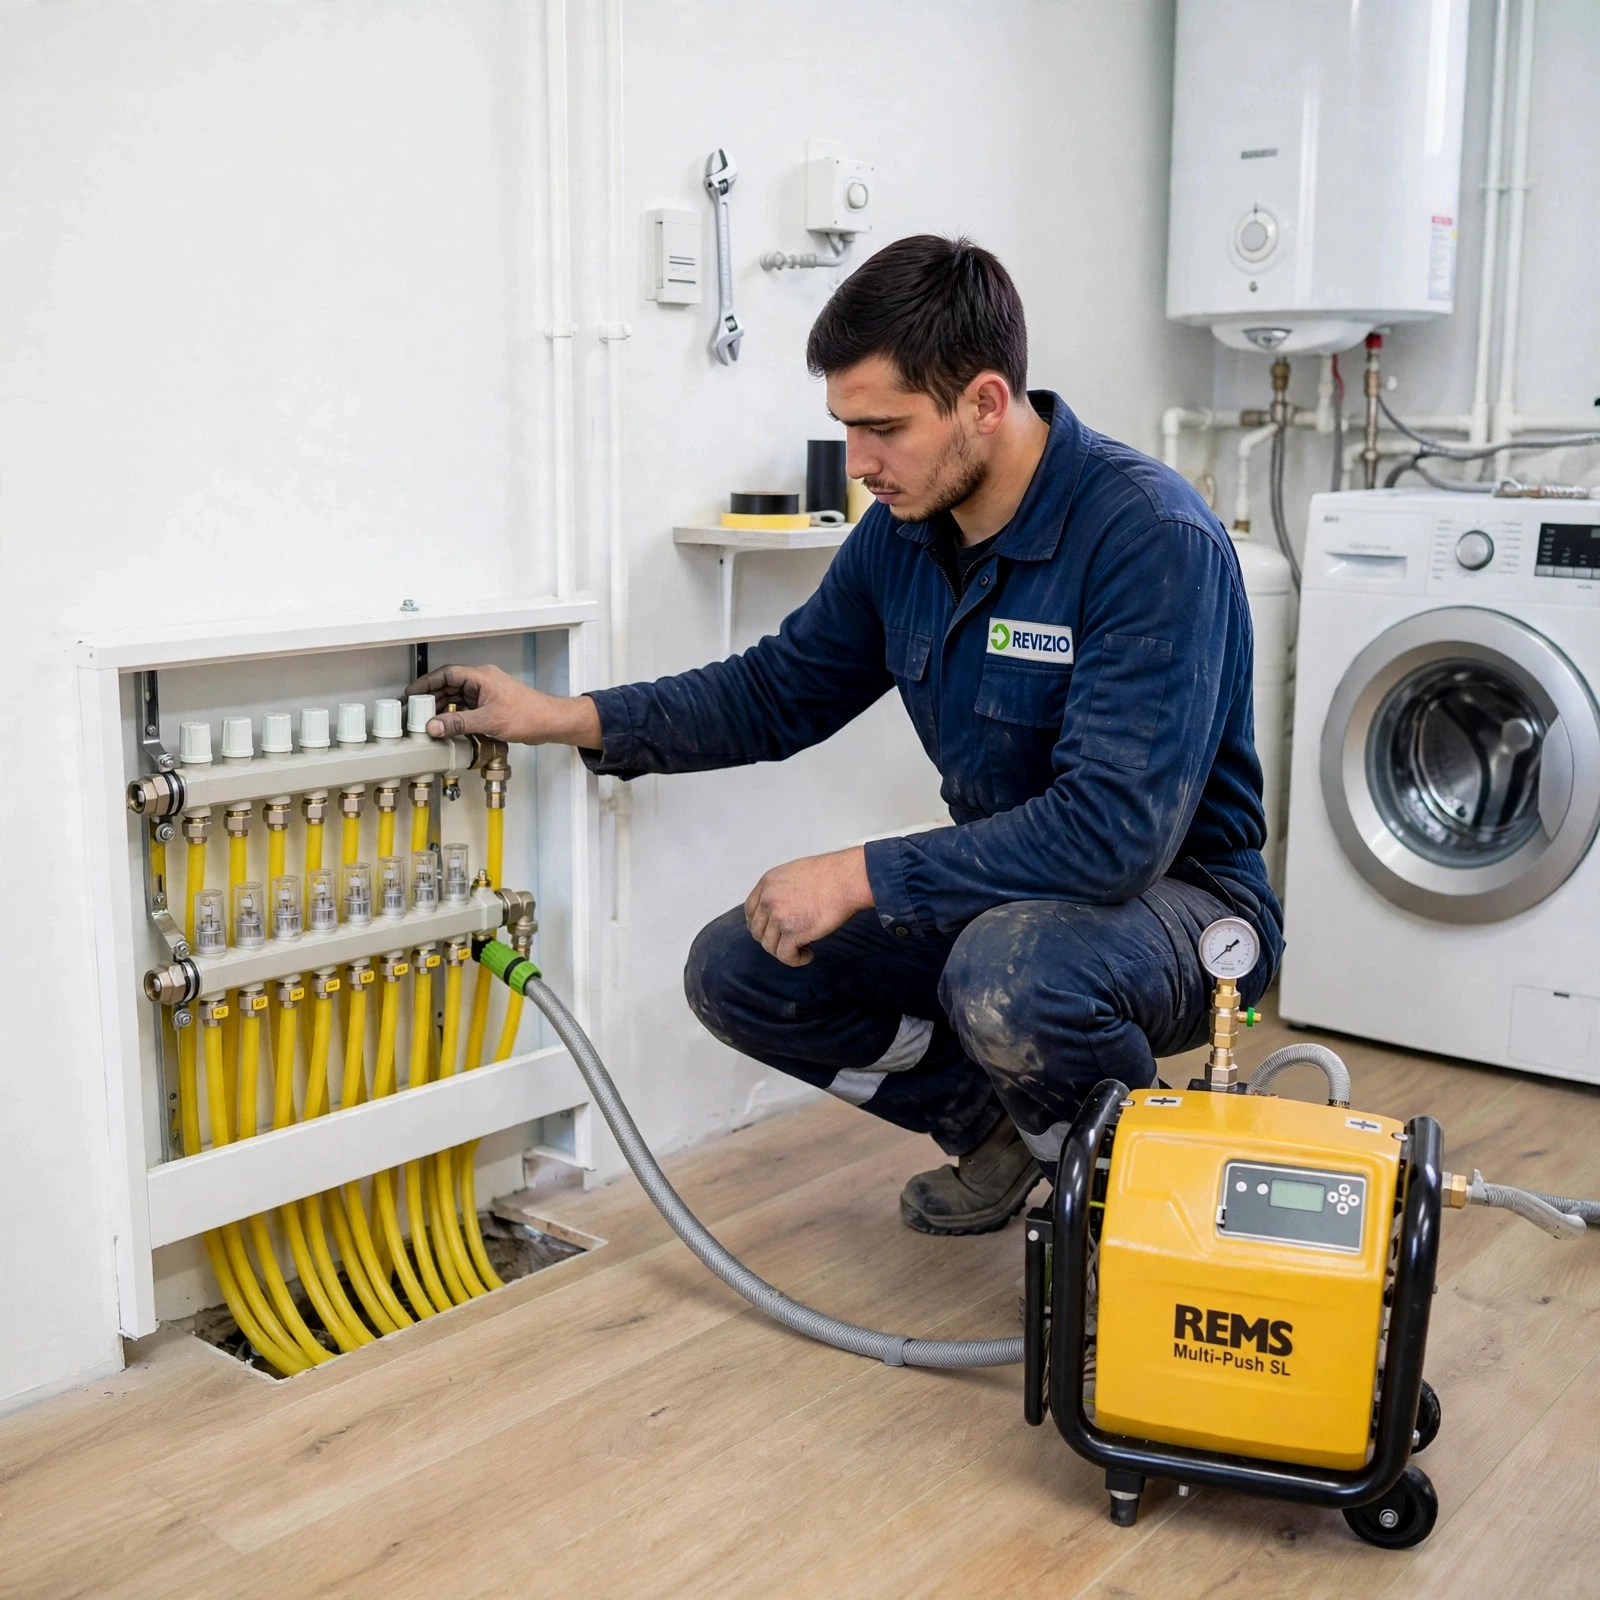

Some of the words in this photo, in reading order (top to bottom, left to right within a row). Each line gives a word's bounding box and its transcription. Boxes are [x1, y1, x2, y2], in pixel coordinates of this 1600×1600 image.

[1012, 630, 1070, 653] REVIZIO
[1174, 1303, 1293, 1357] REMS
[1173, 1343, 1264, 1373] Multi-Push
[1269, 1360, 1291, 1377] SL
